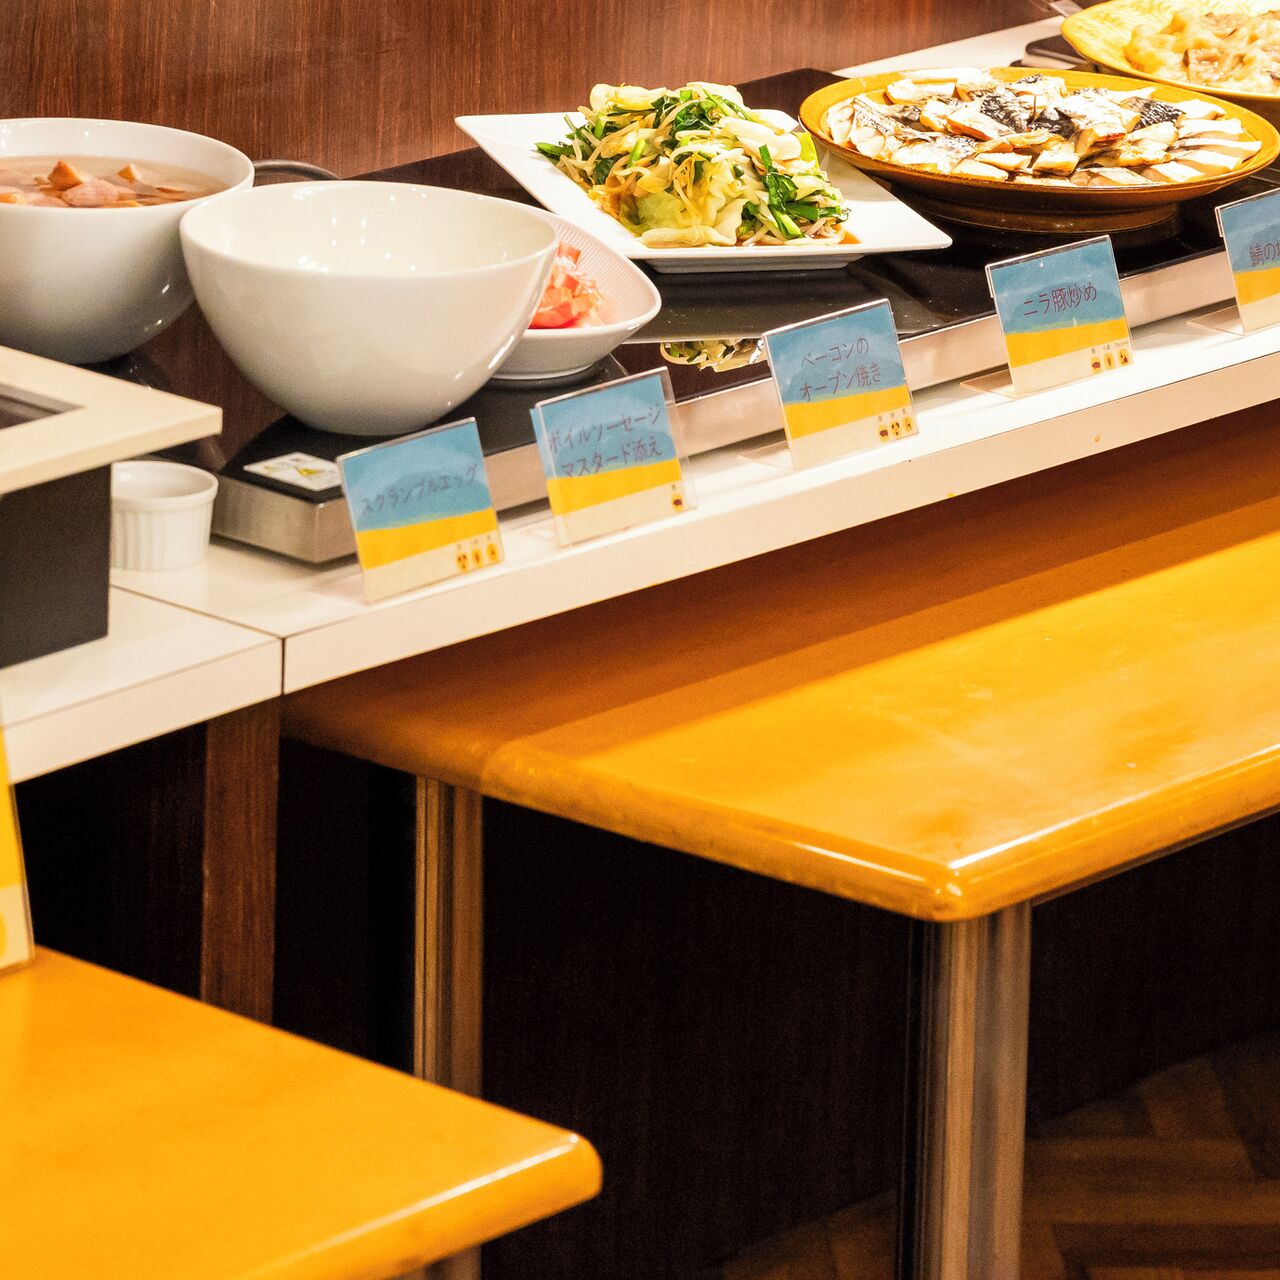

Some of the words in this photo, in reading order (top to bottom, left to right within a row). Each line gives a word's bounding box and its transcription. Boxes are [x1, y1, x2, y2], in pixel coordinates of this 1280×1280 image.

[1024, 282, 1097, 315] ニラ豚炒め
[800, 362, 881, 401] オーブン焼き
[549, 404, 662, 454] ボイルソーセージ
[562, 438, 663, 476] マスタード添え
